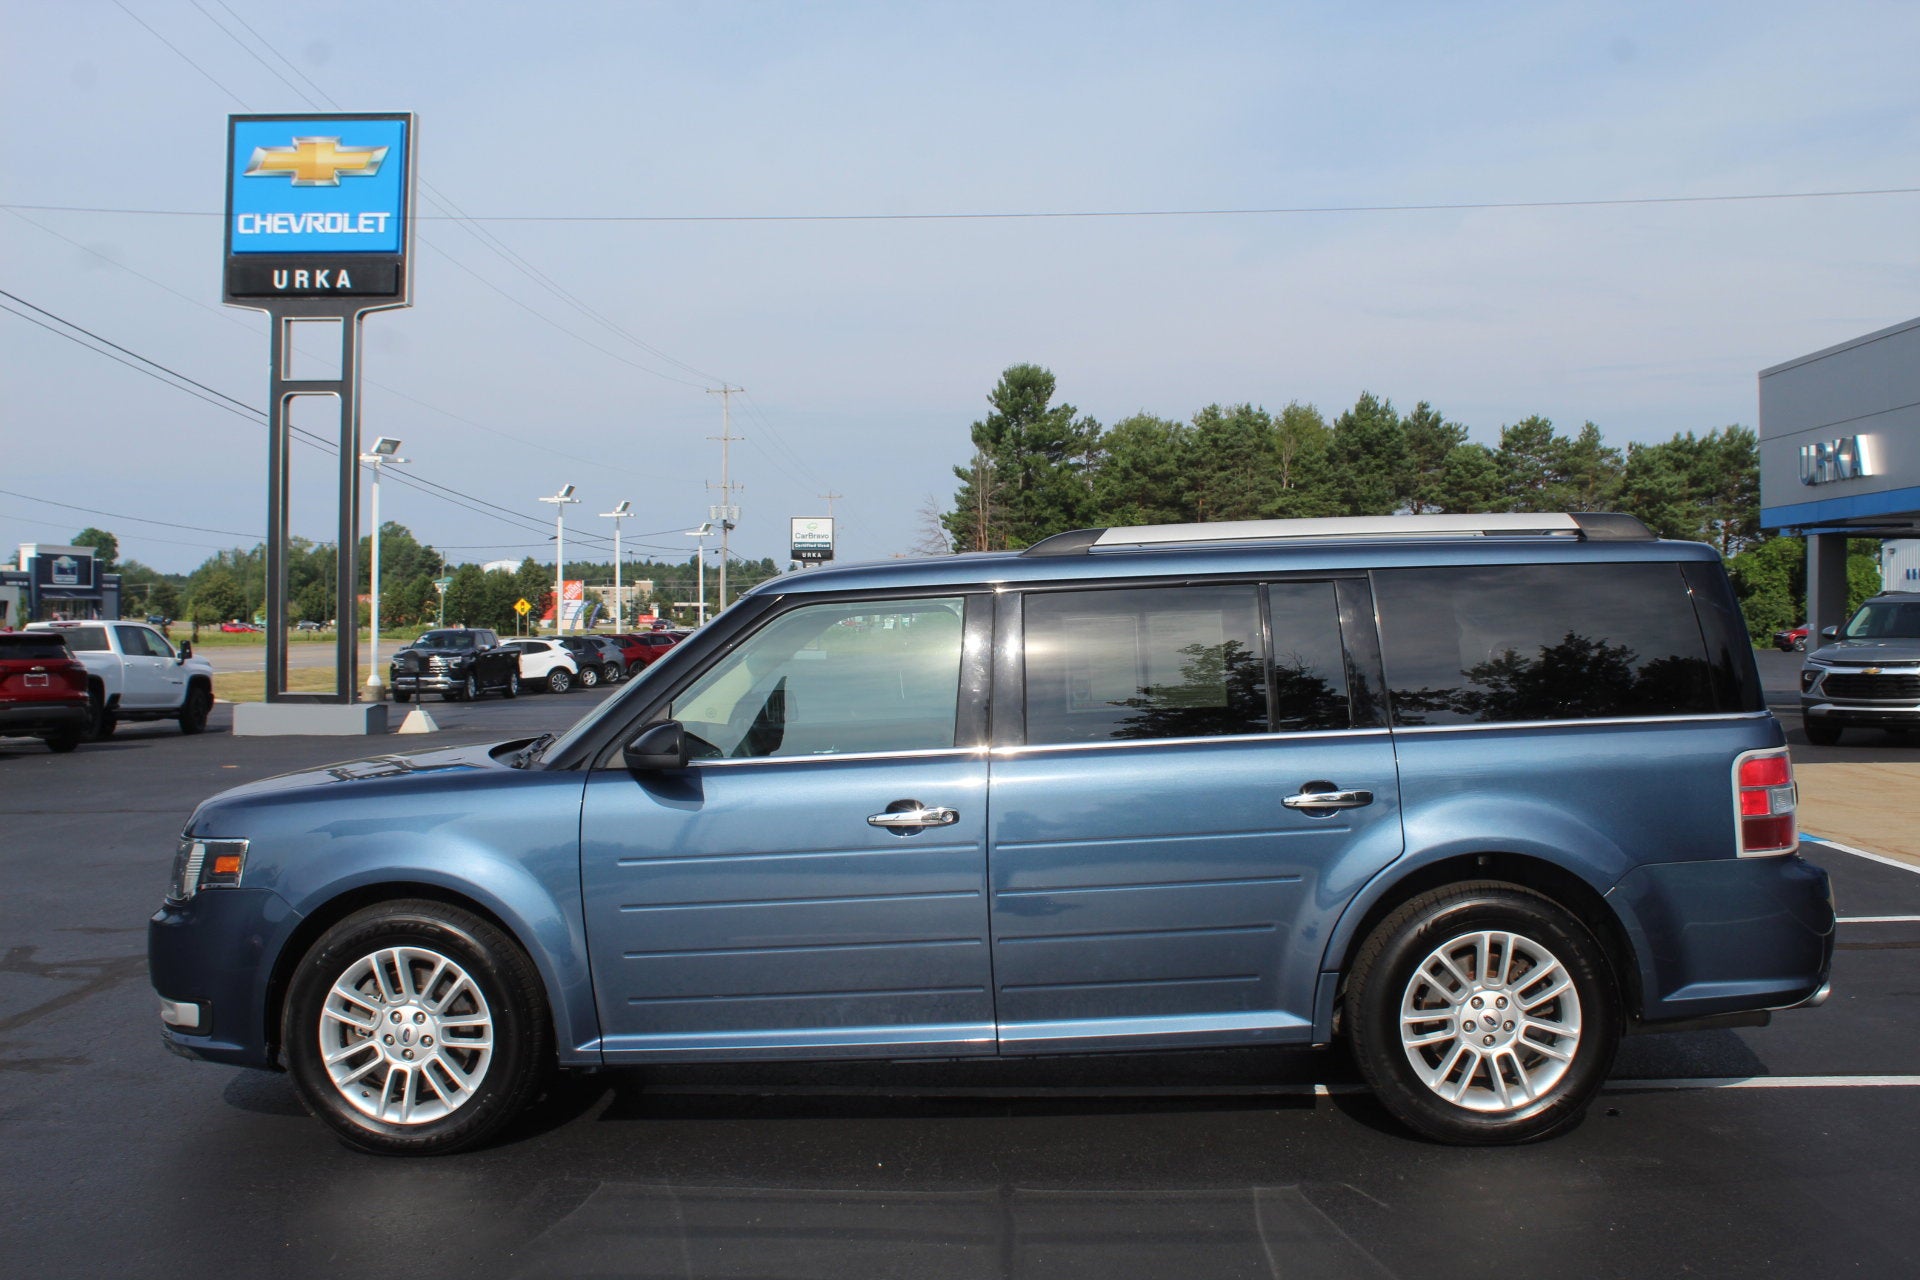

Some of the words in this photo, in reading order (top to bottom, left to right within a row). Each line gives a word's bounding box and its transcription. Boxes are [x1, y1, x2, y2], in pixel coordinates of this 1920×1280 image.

[237, 212, 391, 234] CHEVROLET
[272, 269, 351, 289] URKA
[1800, 433, 1877, 486] URKA
